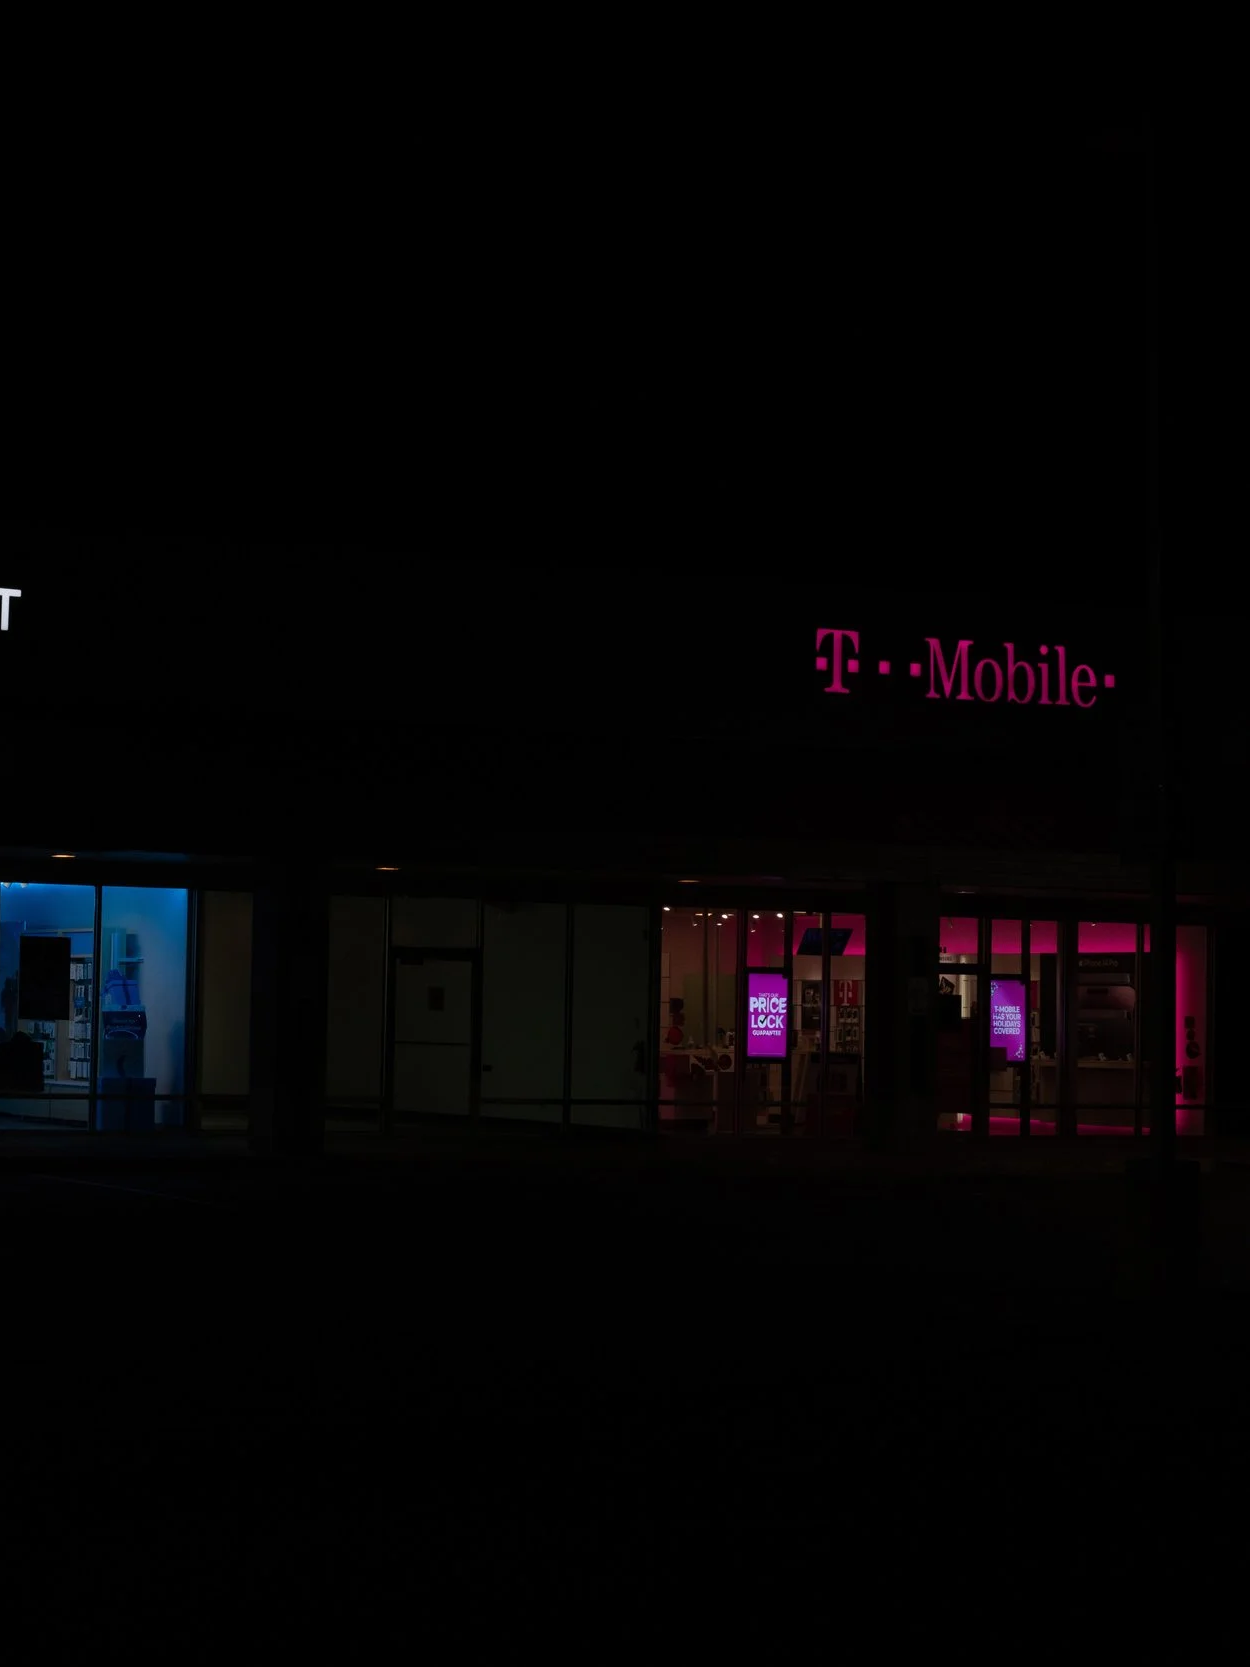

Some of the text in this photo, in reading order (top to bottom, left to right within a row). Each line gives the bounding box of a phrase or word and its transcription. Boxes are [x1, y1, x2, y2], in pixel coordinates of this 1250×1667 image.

[749, 996, 787, 1013] PRICE
[994, 1005, 1020, 1013] T-MOBILE
[992, 1012, 1021, 1020] HAS YOUR
[751, 1014, 784, 1029] LOCK
[993, 1020, 1021, 1028] HOLIDAYS
[993, 1027, 1021, 1035] COVERED
